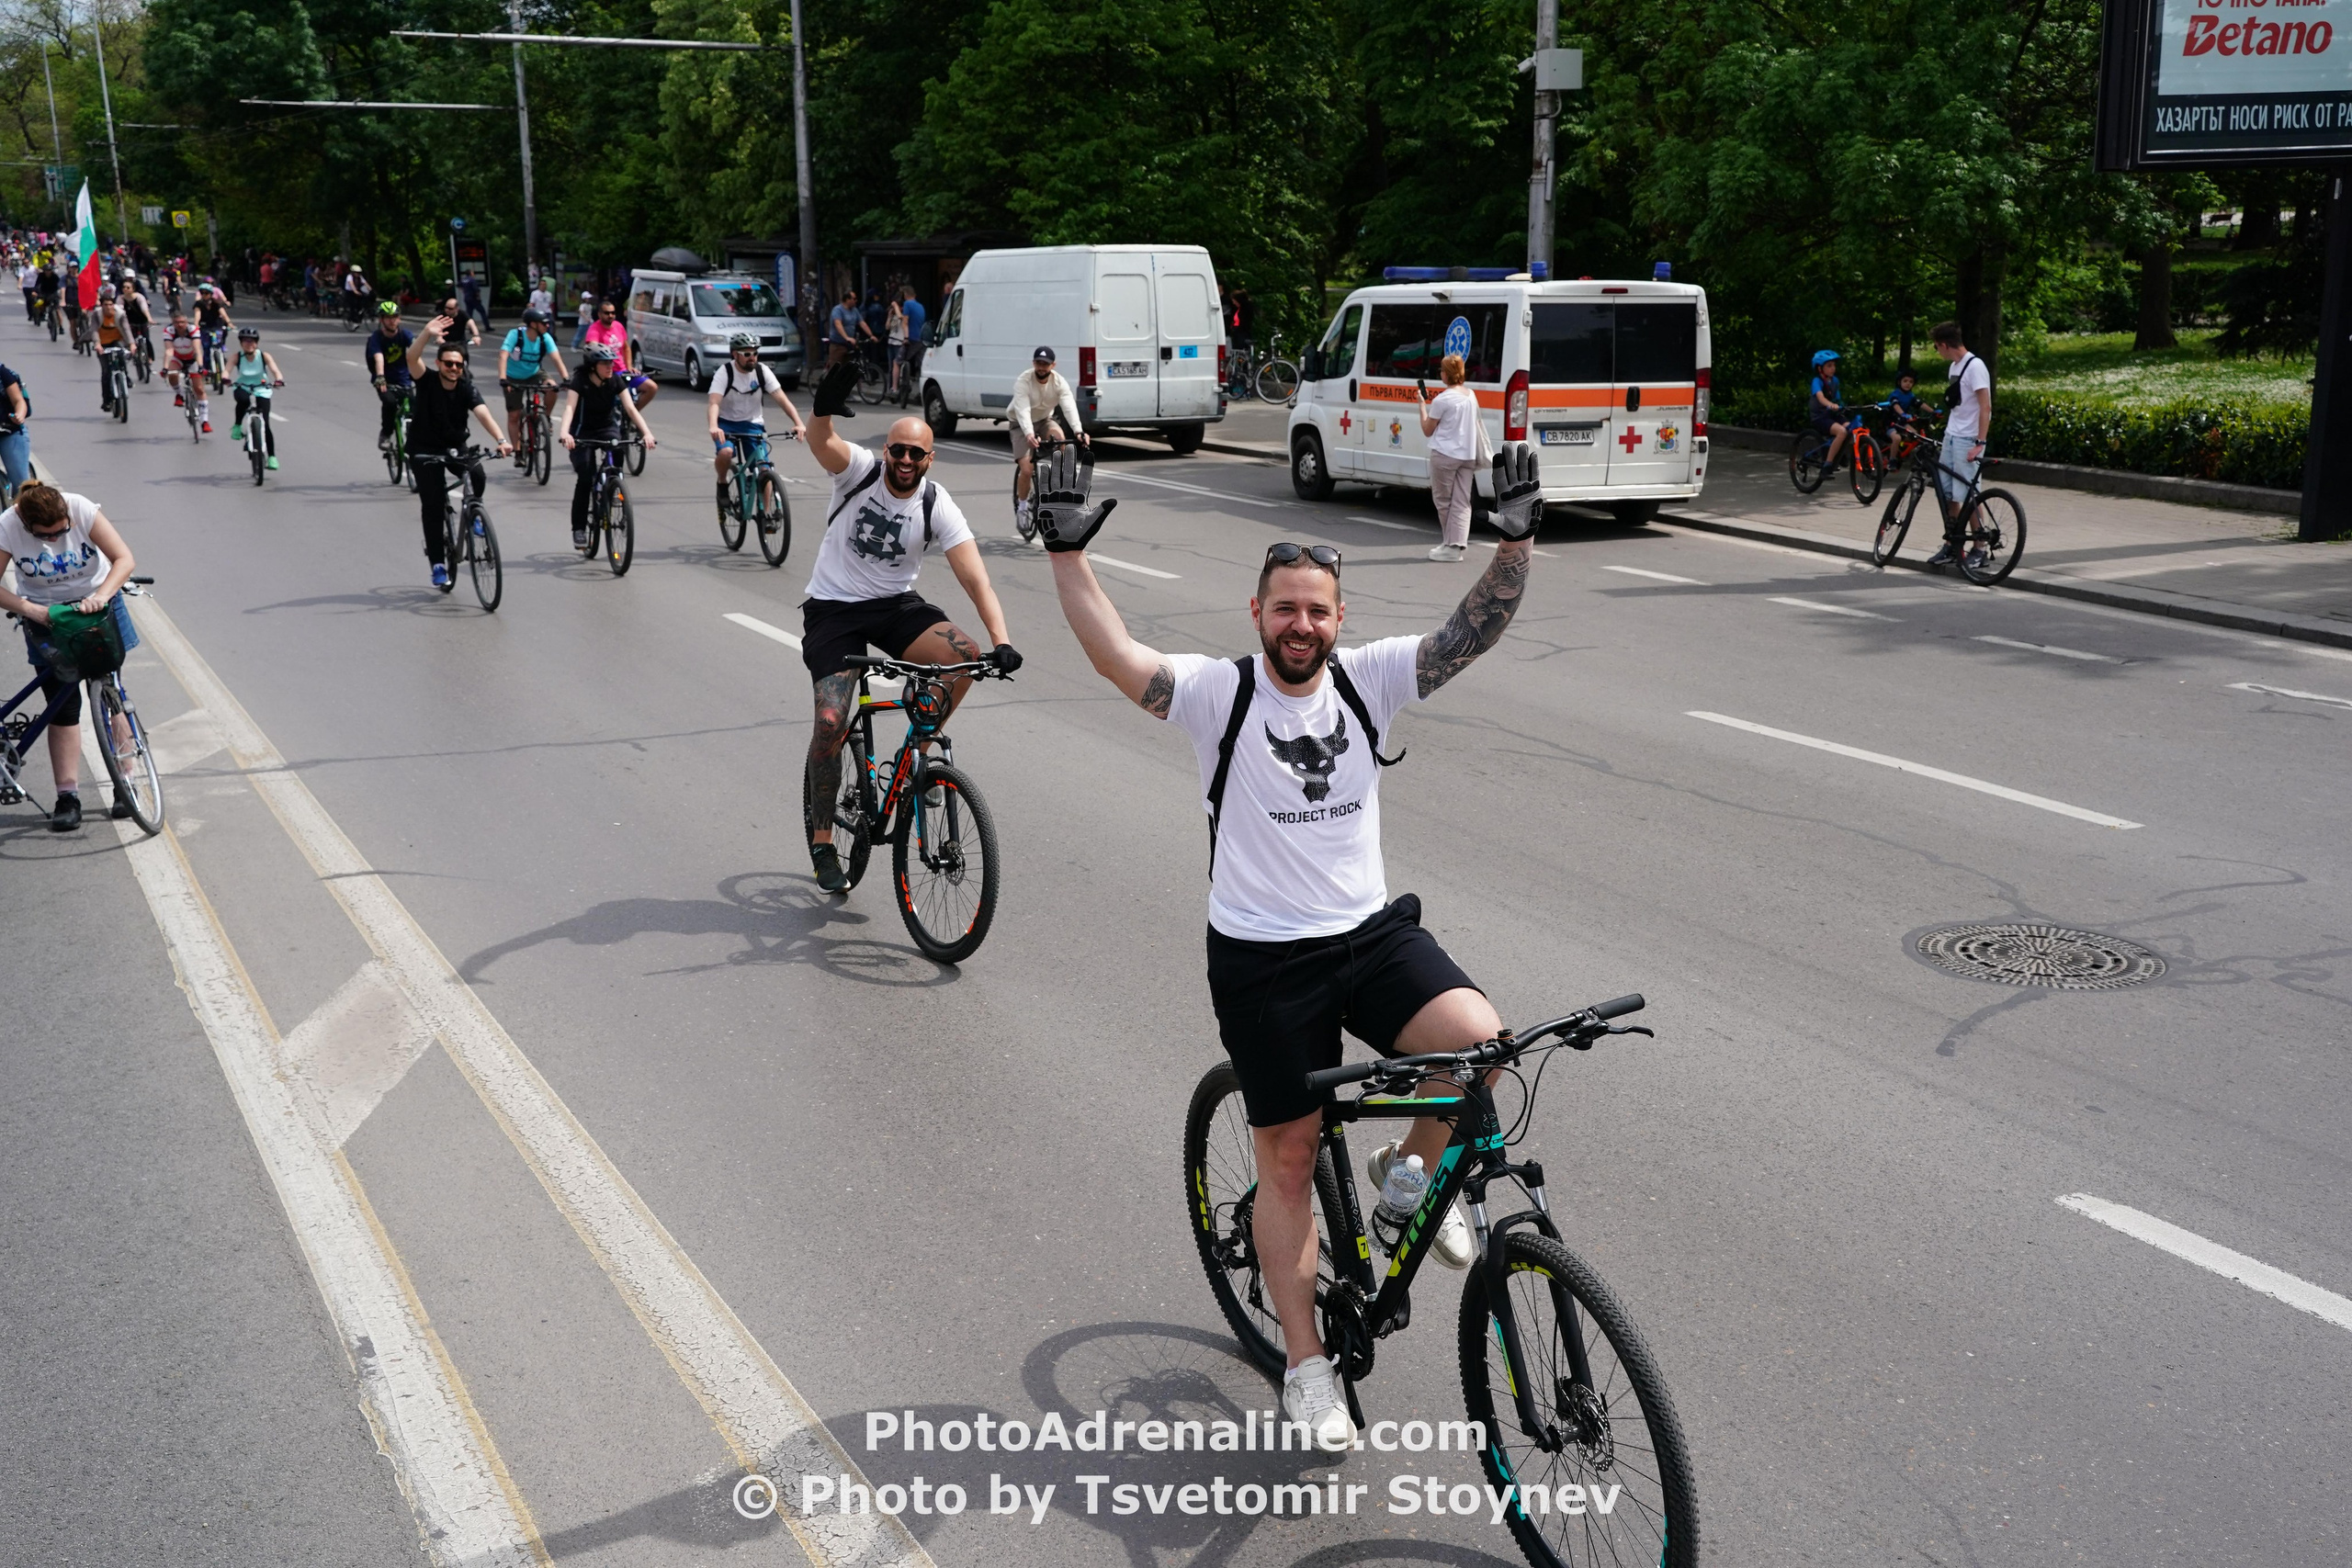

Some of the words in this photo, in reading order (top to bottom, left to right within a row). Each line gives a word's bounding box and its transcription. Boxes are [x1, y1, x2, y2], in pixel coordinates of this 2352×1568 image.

[2182, 15, 2333, 56] Betano
[2155, 106, 2225, 132] ХАЗАРТЪТ
[2230, 104, 2268, 130] НОСИ
[2274, 104, 2311, 129] РИСК
[2314, 103, 2334, 128] ОТ
[1369, 386, 1393, 398] ПЪРВА
[1547, 431, 1558, 442] CB
[1559, 431, 1579, 441] 7820
[1581, 431, 1592, 441] AK
[901, 793, 914, 818] KENDA
[1269, 808, 1326, 824] PROJECT
[1330, 799, 1363, 818] ROCK
